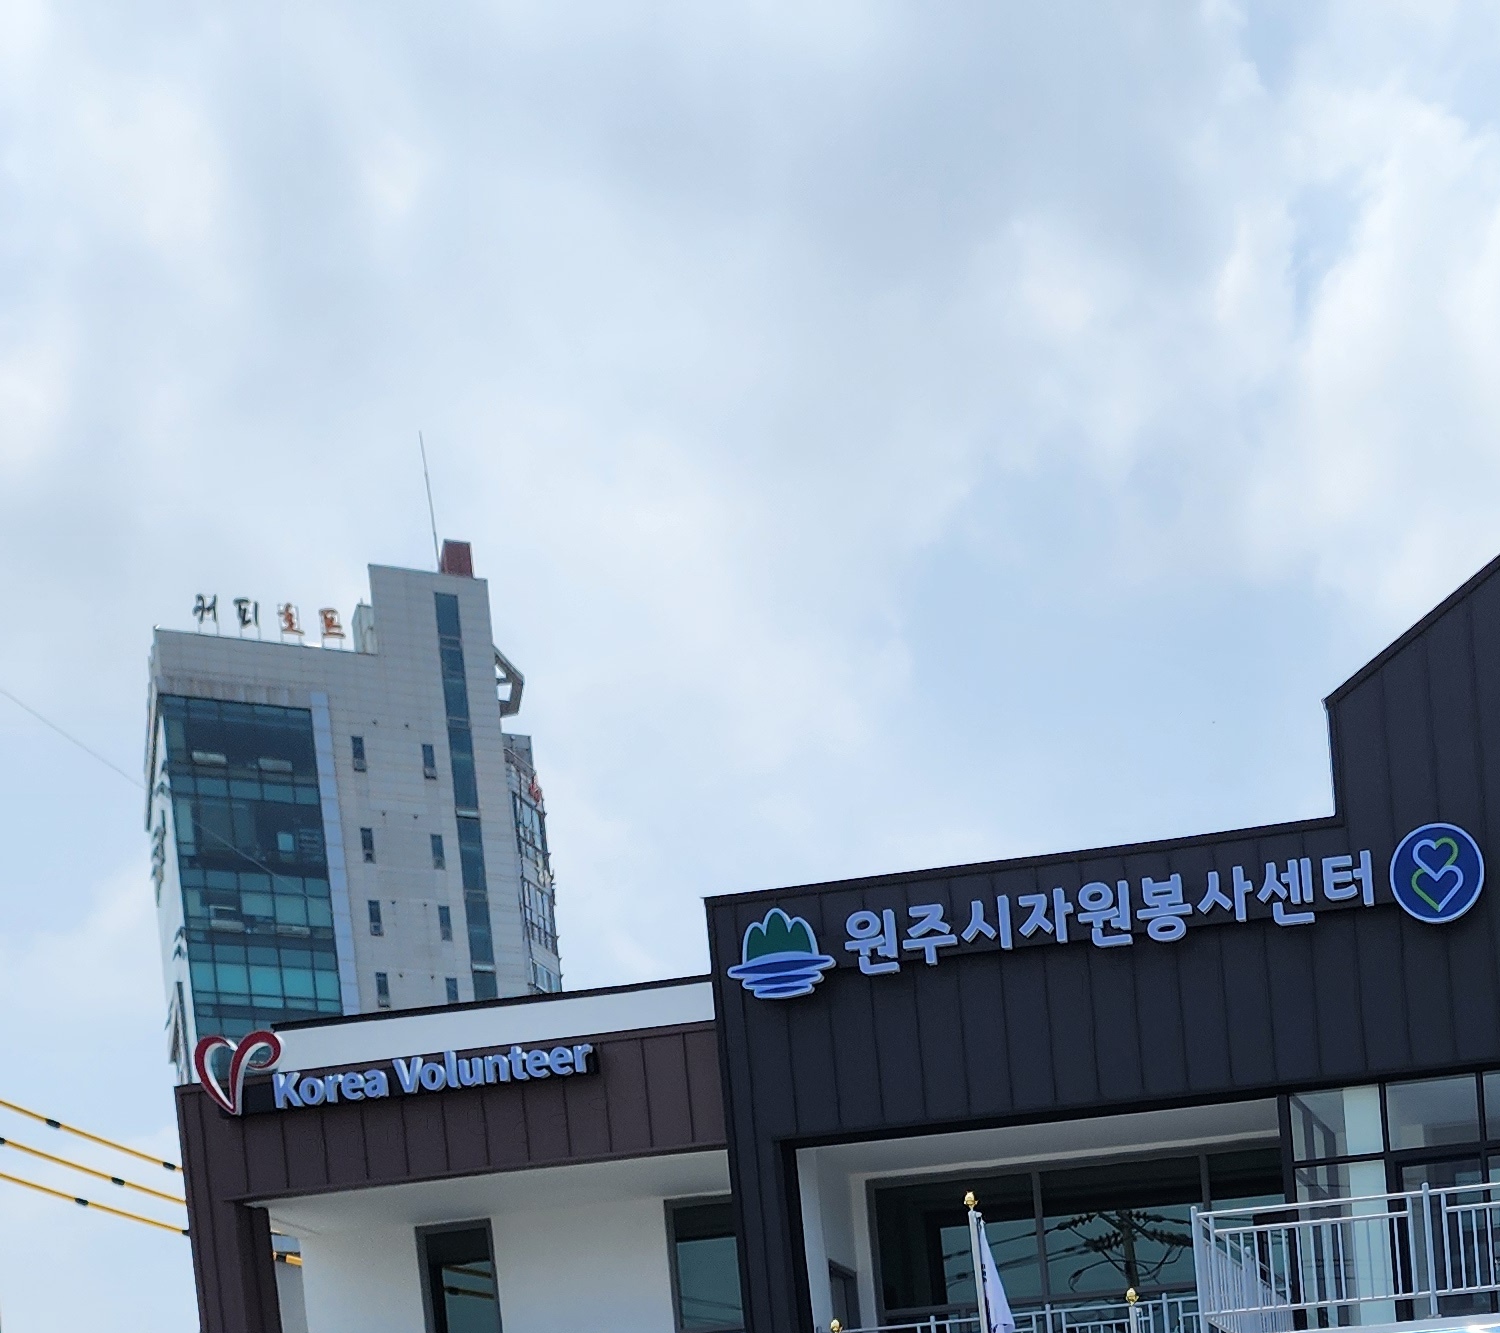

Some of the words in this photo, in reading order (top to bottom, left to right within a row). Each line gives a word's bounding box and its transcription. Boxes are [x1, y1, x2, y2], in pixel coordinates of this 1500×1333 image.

[845, 850, 1376, 976] 원주시자원봉사센터
[272, 1067, 389, 1109] Korea
[392, 1043, 594, 1094] Volunteer
